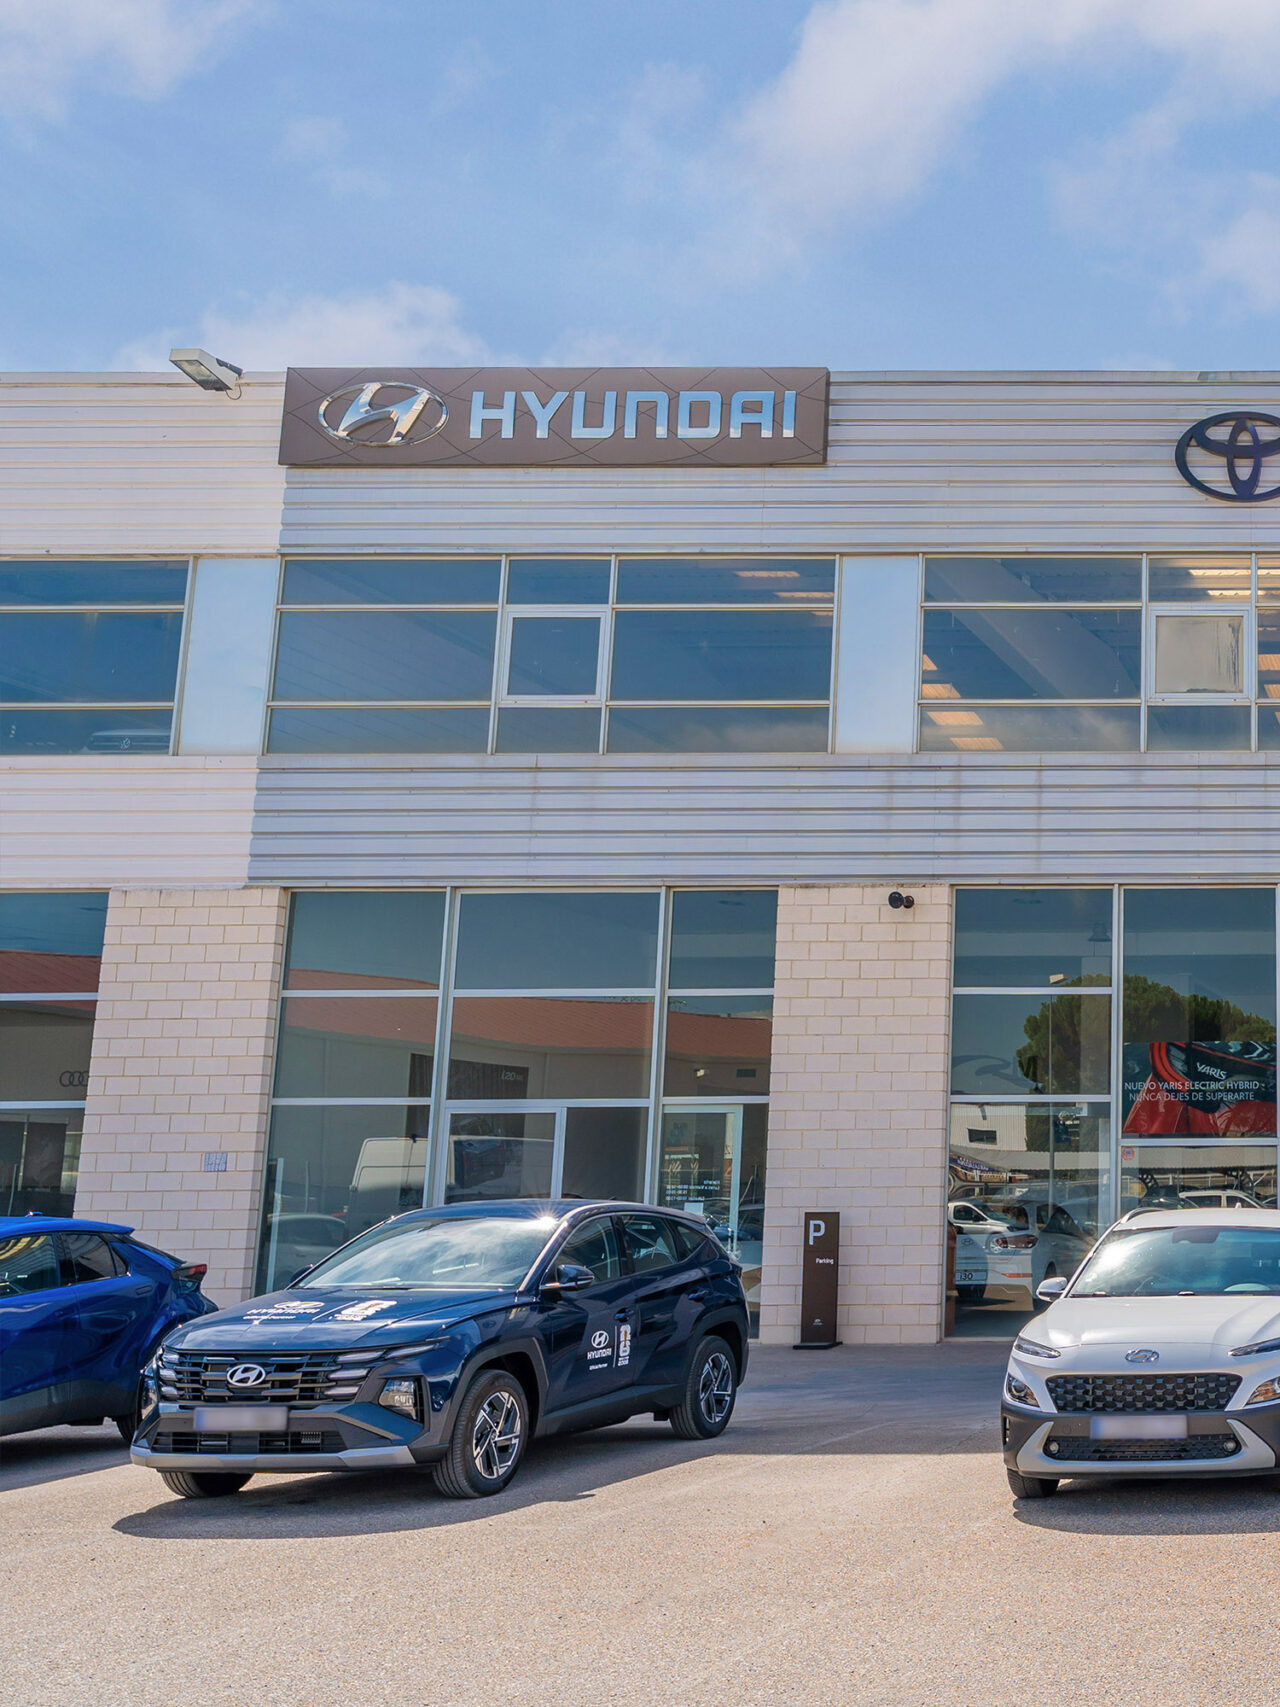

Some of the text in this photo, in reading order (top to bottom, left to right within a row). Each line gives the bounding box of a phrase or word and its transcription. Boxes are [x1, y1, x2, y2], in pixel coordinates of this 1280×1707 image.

[469, 390, 797, 439] HYUNDAI
[1196, 1062, 1227, 1080] YARIS
[1124, 1080, 1260, 1090] NUEVO YARIS ELECTRIC HYBRID
[1129, 1091, 1255, 1102] NUNCA DEJES DE SUPERARTE
[808, 1219, 826, 1246] P
[586, 1347, 612, 1360] HYUNDAI
